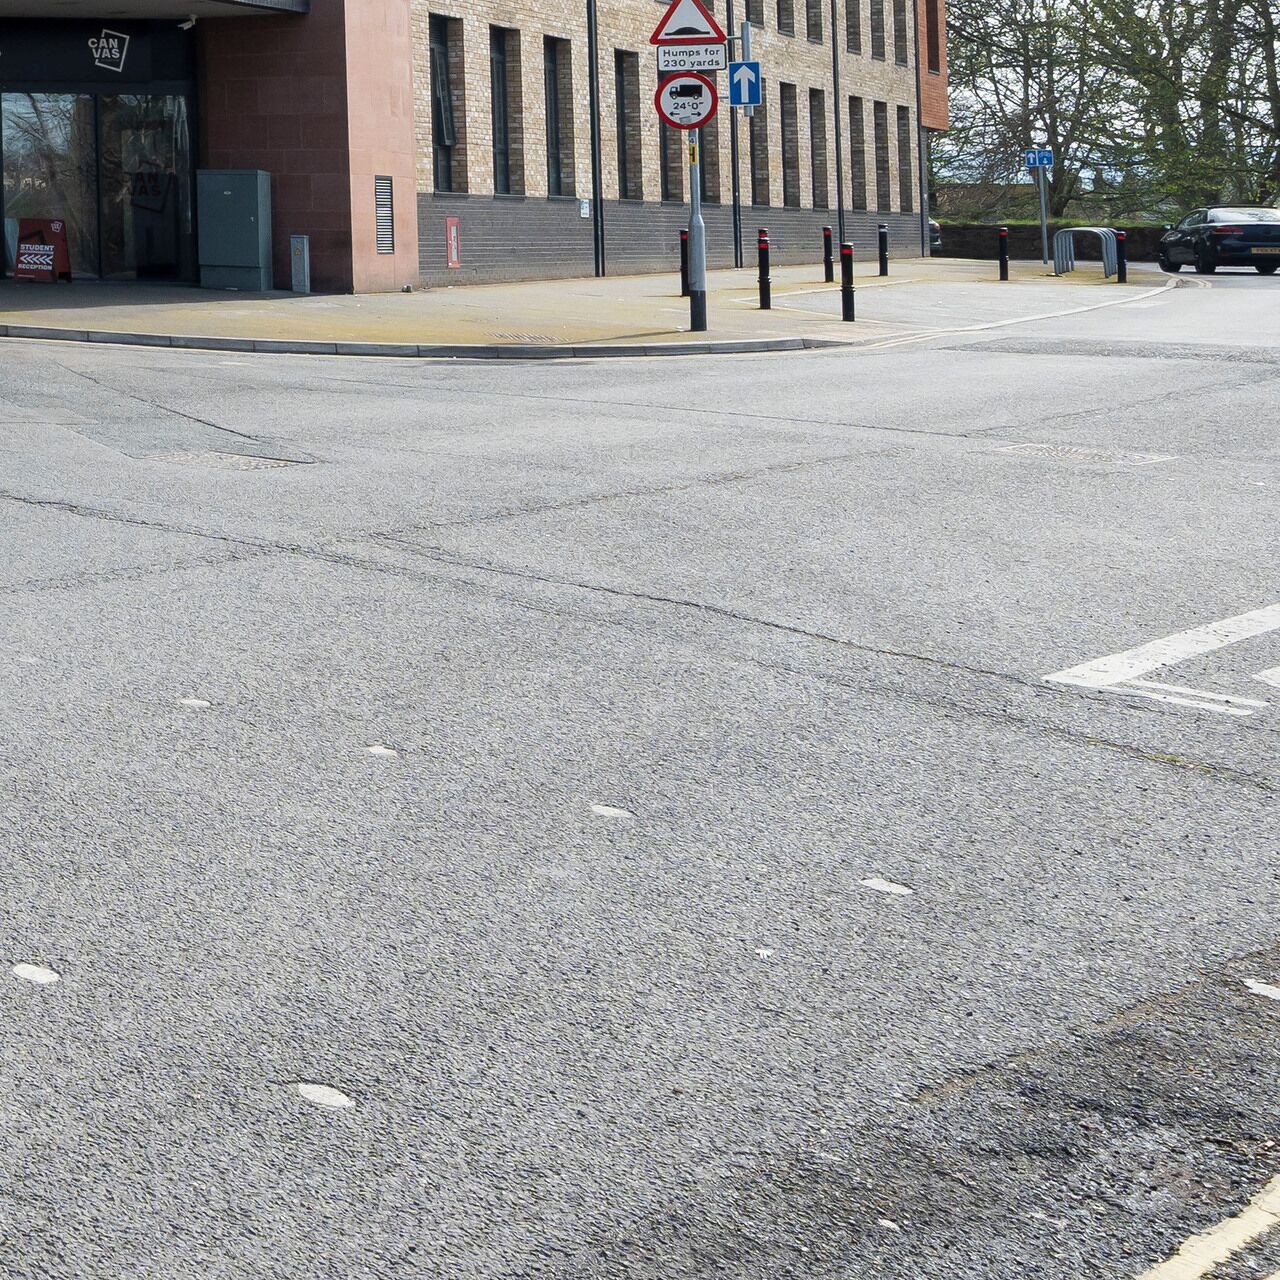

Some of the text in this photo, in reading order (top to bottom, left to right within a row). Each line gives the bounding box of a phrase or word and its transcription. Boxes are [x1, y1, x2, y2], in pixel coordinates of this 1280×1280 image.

[88, 38, 118, 49] CAN
[92, 48, 120, 58] VAS
[663, 48, 720, 57] Humps for
[663, 59, 720, 68] 230 yards
